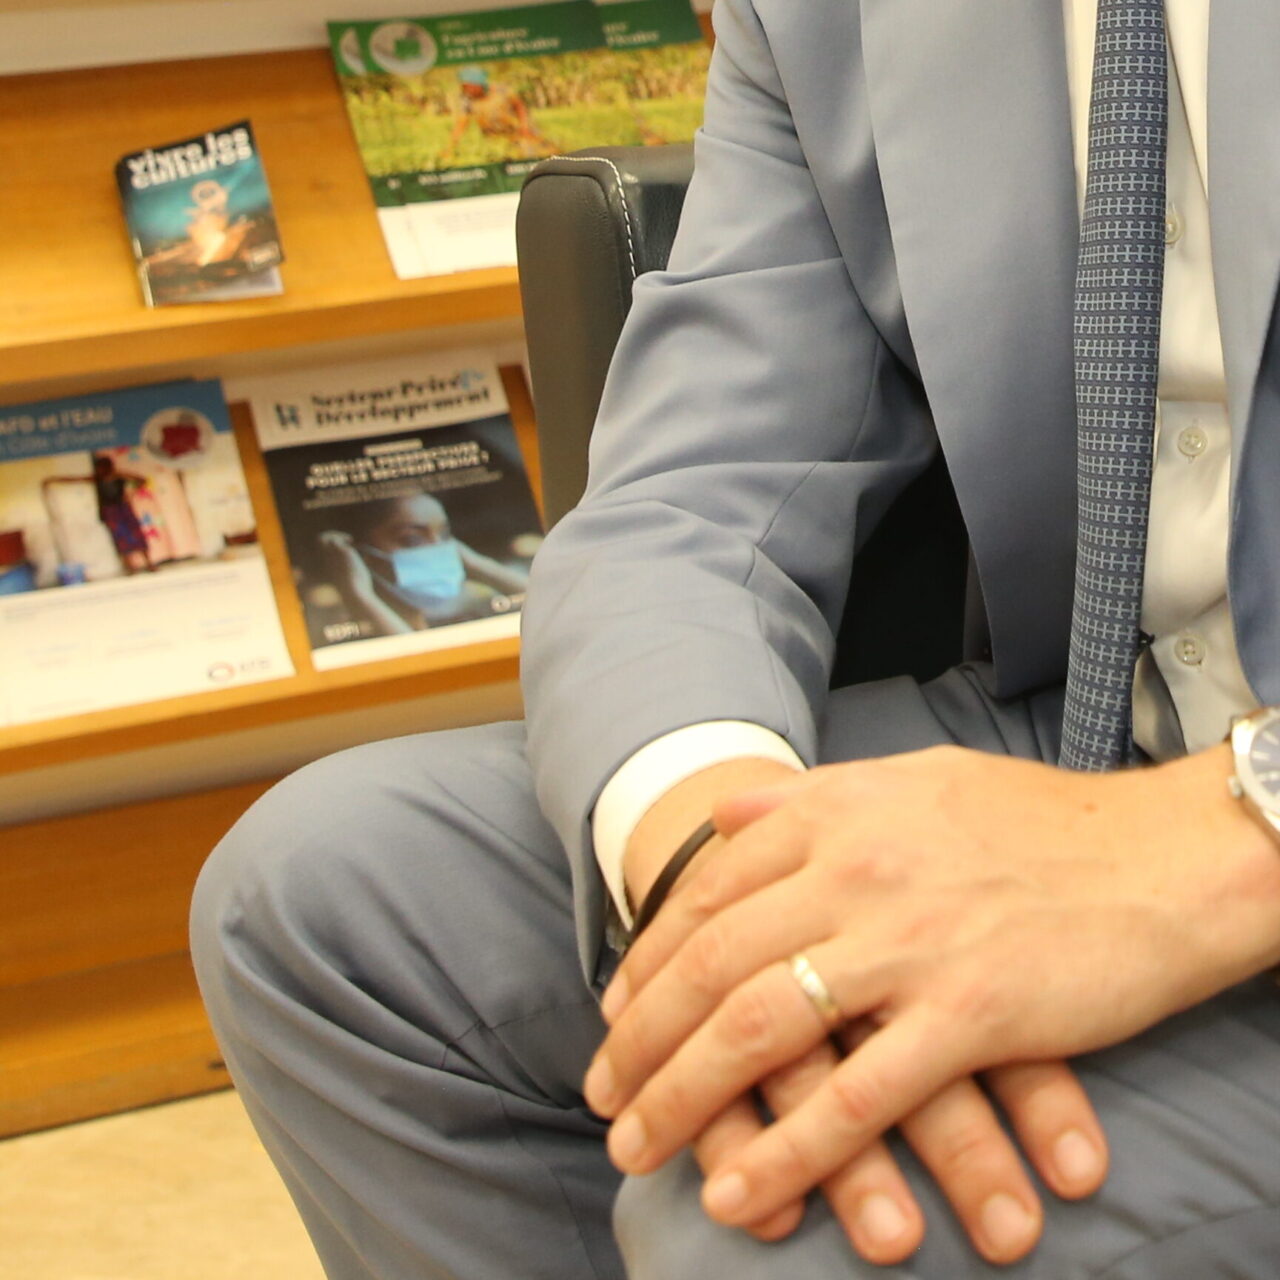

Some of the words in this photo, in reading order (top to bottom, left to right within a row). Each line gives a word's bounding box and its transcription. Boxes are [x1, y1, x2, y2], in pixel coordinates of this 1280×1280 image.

[127, 142, 203, 172] vivre
[205, 127, 250, 154] les
[131, 144, 252, 189] cultures
[311, 387, 395, 409] Secteur
[316, 387, 490, 426] Développement
[305, 472, 349, 490] POUR
